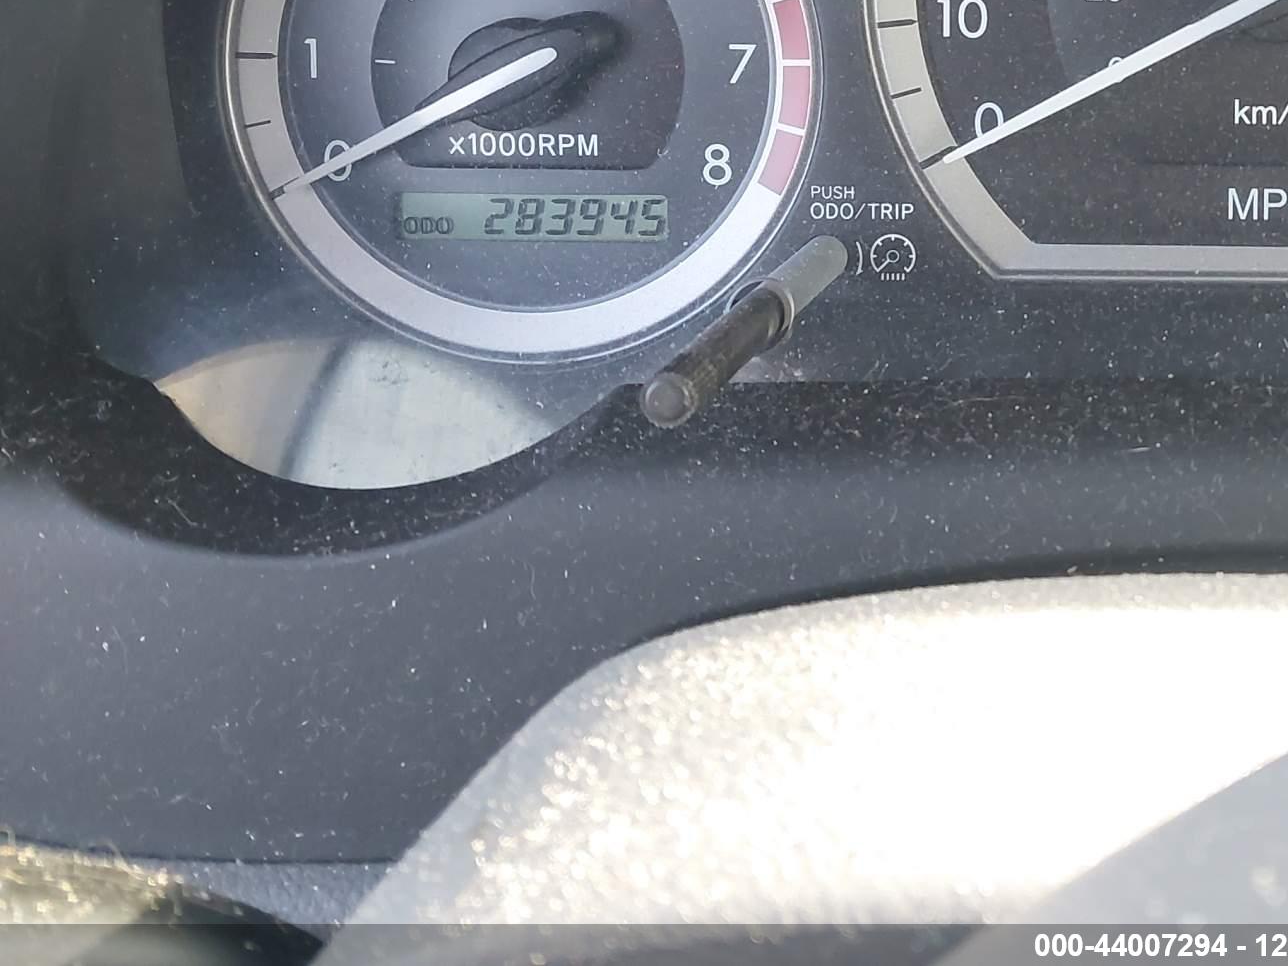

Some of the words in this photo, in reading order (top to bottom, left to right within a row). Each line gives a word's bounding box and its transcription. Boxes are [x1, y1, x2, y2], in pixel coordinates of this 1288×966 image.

[304, 39, 317, 78] 1
[729, 44, 756, 83] 7
[324, 139, 352, 181] 0
[702, 144, 732, 185] 8
[810, 186, 855, 200] PUSH
[810, 202, 914, 220] ODO/TRIP
[403, 216, 454, 234] ODO
[484, 198, 667, 236] 283945
